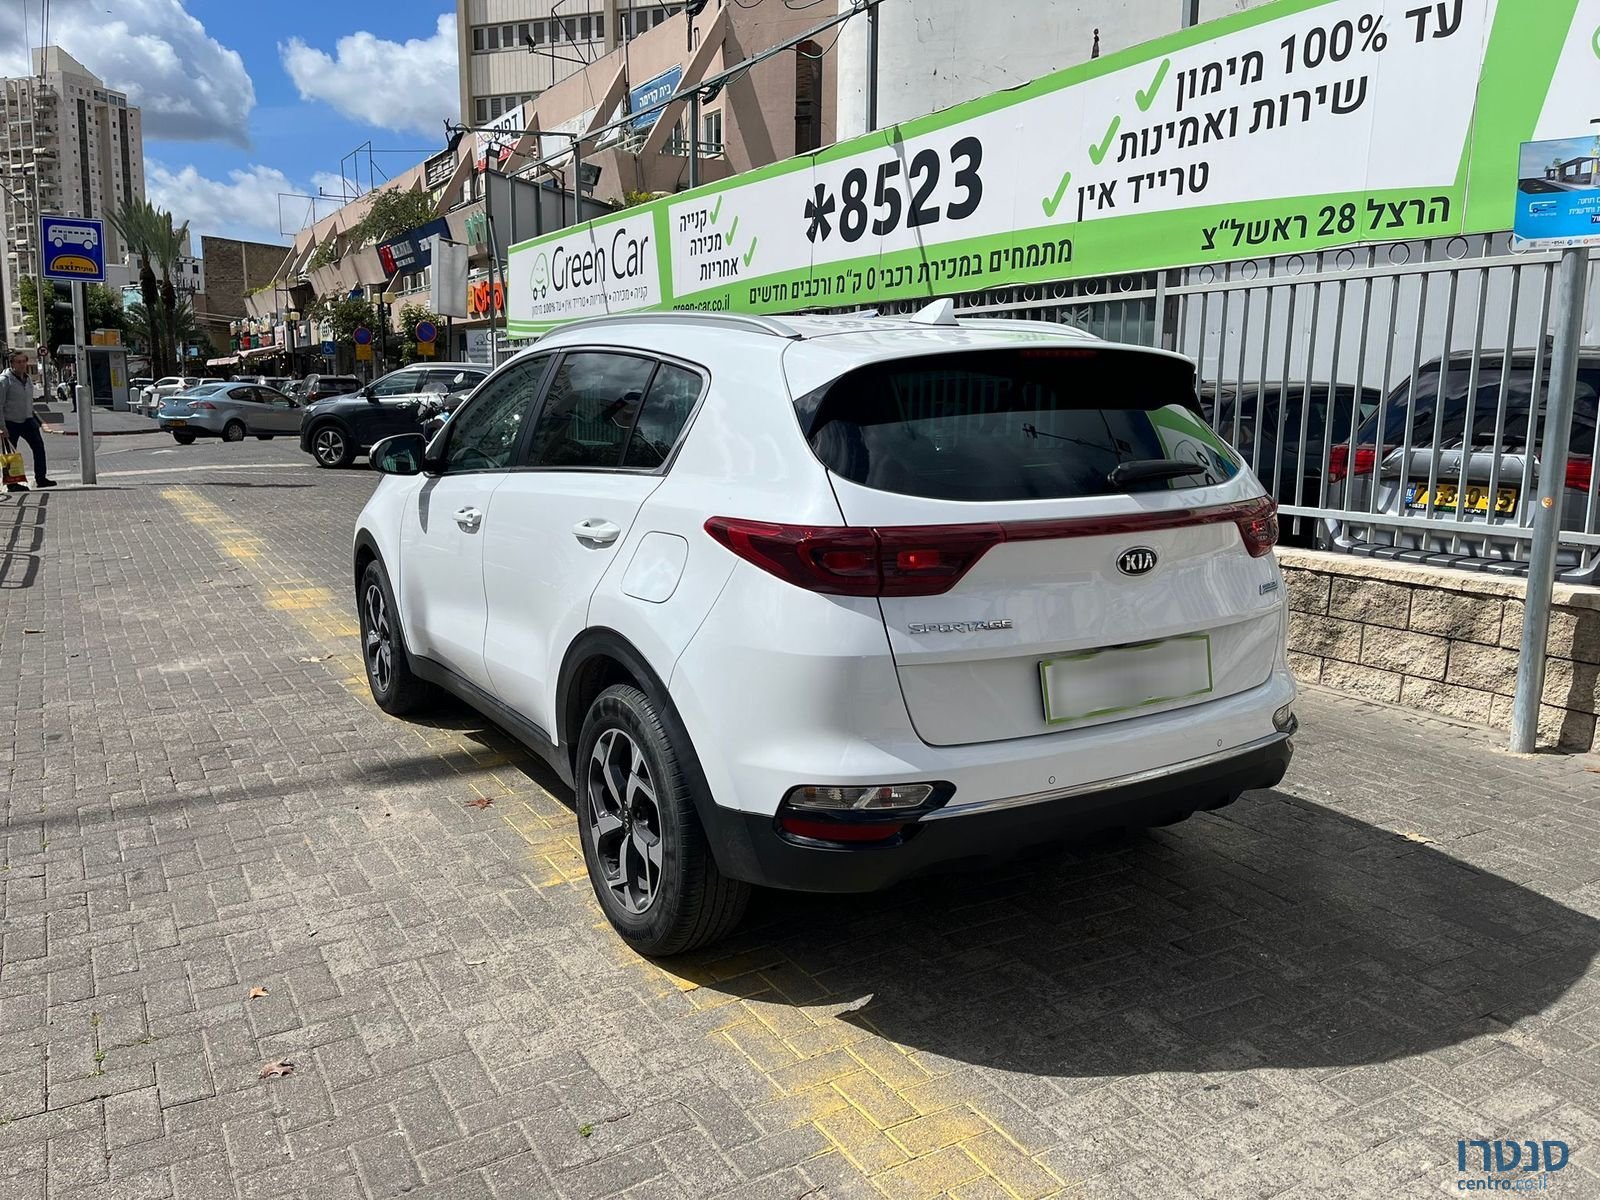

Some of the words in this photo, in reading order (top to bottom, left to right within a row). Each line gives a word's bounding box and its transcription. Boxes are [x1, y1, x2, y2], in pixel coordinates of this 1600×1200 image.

[1405, 0, 1463, 43] עד
[1281, 13, 1388, 74] 100%
[659, 84, 671, 98] בית
[1176, 50, 1264, 111] מימון
[1249, 75, 1368, 133] שירות
[1117, 107, 1238, 162] ואמינות
[1128, 161, 1209, 203] טרייד
[1077, 178, 1117, 221] אין
[1367, 195, 1450, 230] הרצל
[680, 209, 707, 232] קנייה
[1317, 202, 1356, 236] 28
[551, 245, 605, 292] Green
[611, 228, 649, 280] Car
[690, 233, 722, 256] מכירה
[990, 238, 1072, 272] מתמחים
[699, 257, 739, 281] אחריות
[866, 267, 876, 289] 0
[880, 265, 913, 288] רכבי
[919, 254, 983, 282] במכירת
[749, 282, 787, 305] חדשים
[791, 279, 832, 300] ורכבים
[1125, 552, 1155, 571] KIA
[907, 618, 1013, 635] SPORTAGE
